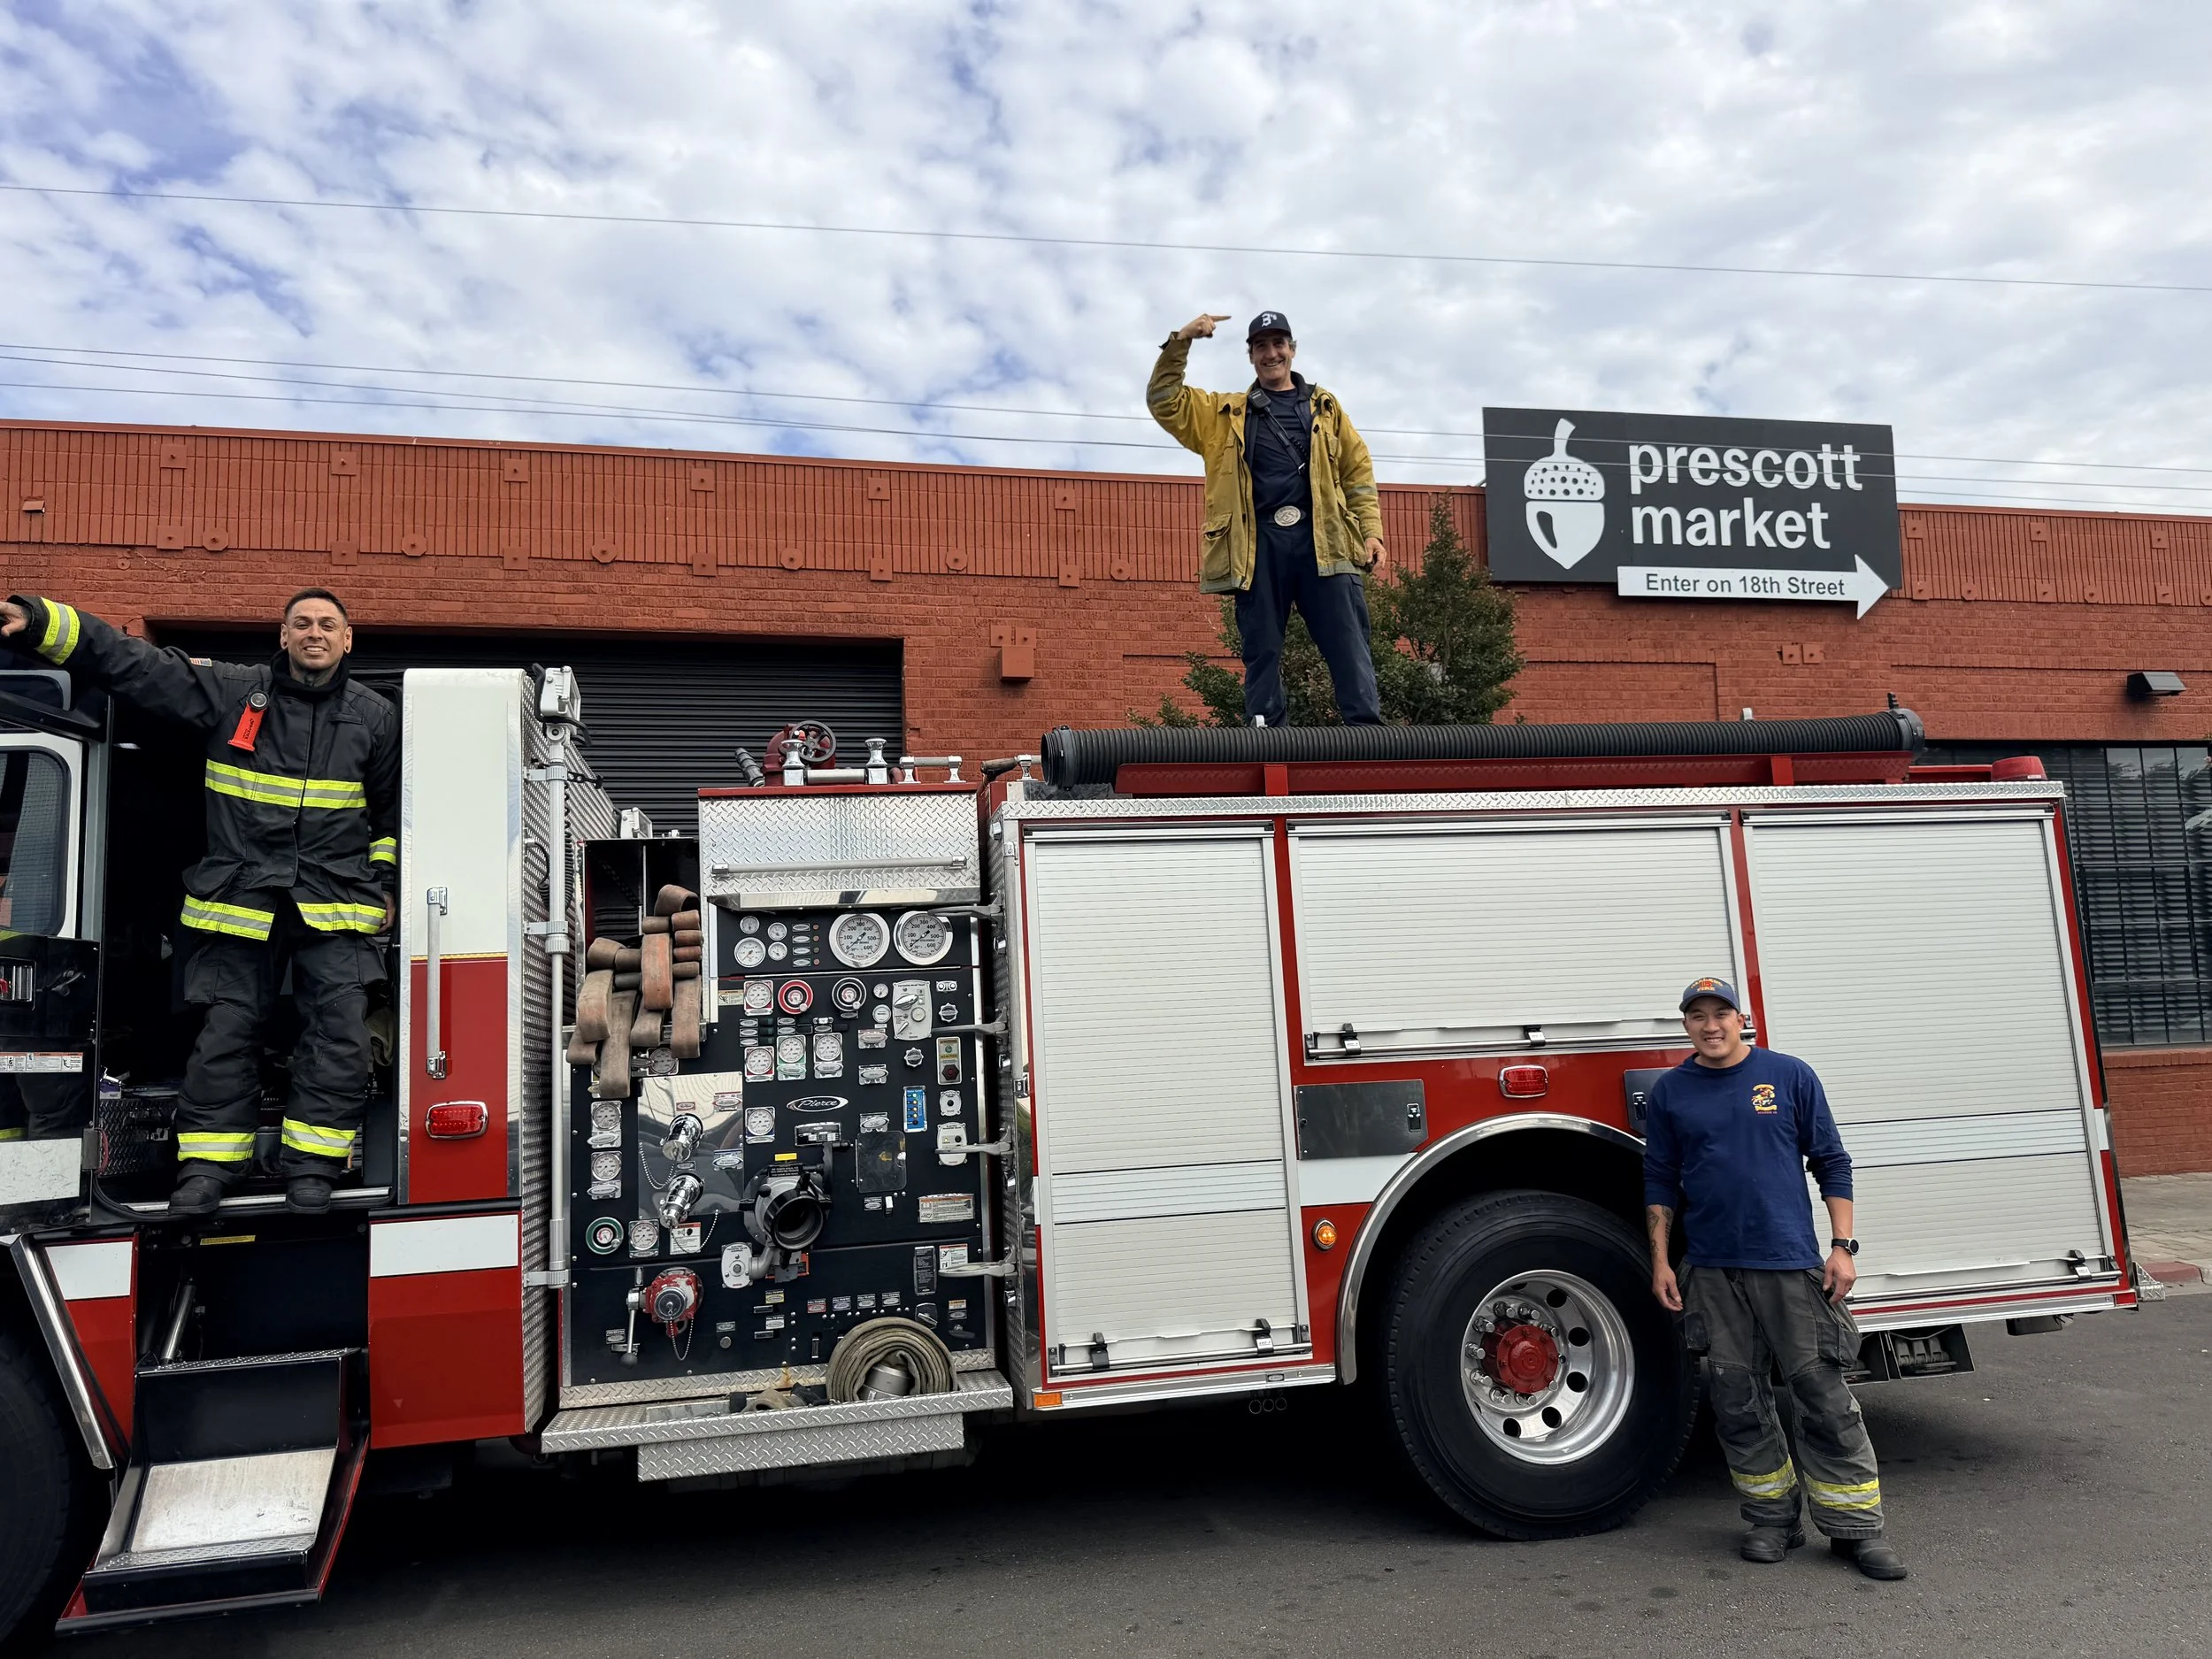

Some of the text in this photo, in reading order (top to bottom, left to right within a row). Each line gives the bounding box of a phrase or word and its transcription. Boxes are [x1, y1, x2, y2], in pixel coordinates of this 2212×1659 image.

[1629, 443, 1863, 495] prescott
[1632, 497, 1831, 549] market
[1646, 573, 1845, 595] Enter on 18th Street
